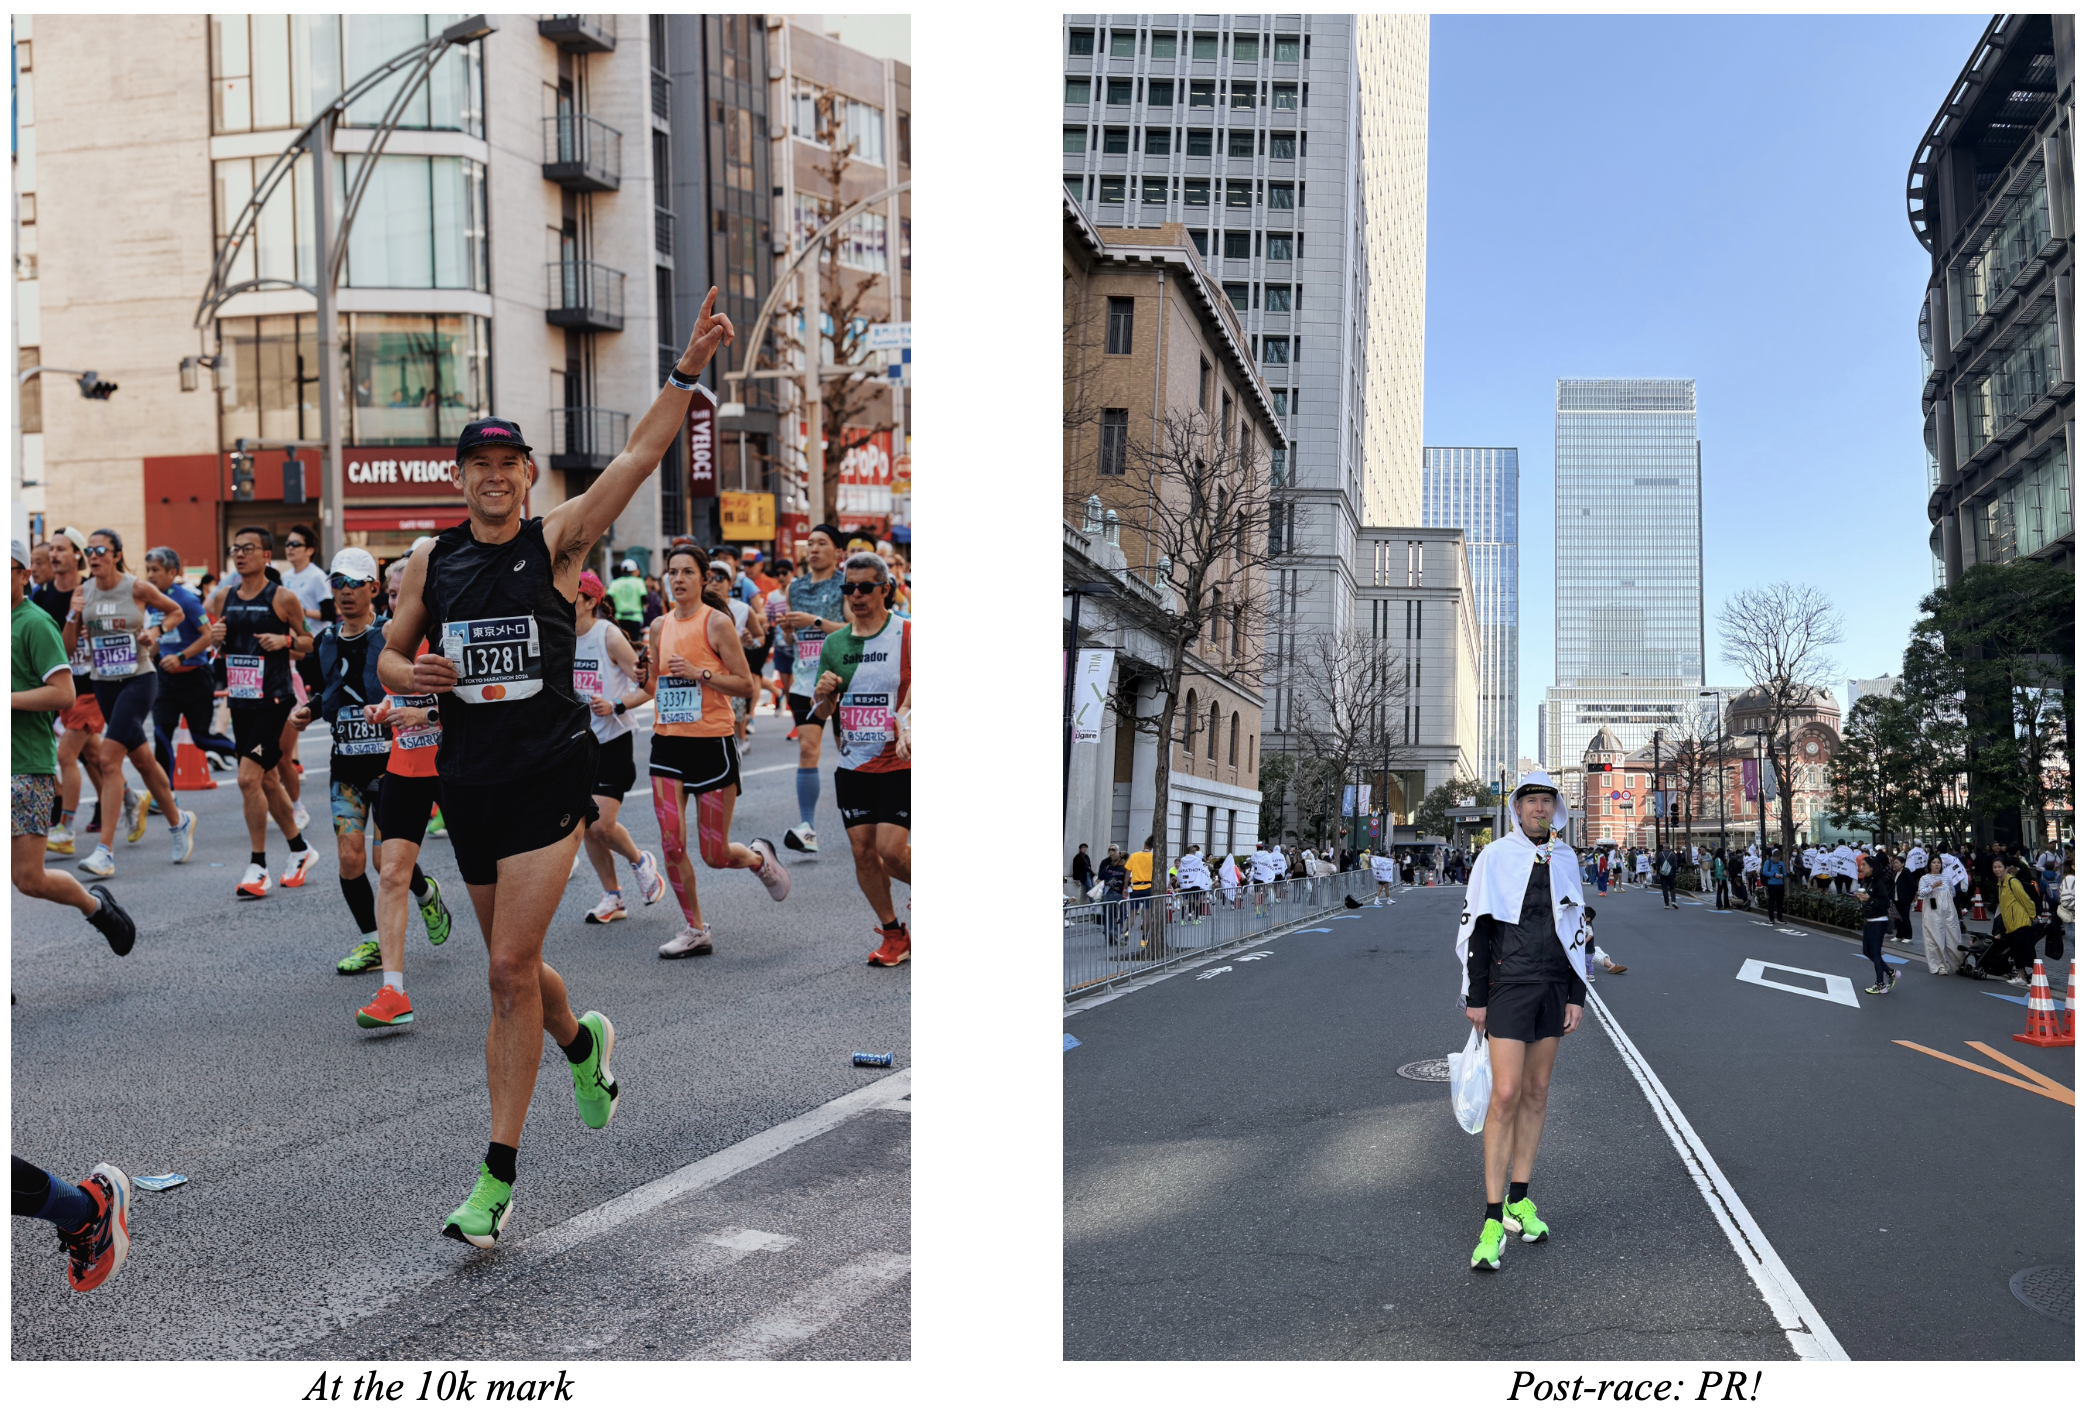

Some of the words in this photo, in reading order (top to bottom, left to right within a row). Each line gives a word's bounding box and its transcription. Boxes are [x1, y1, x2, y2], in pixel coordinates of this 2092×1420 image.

[691, 420, 712, 480] VELOCE
[472, 624, 526, 638] 東京メトロ
[102, 647, 130, 663] 31657
[467, 645, 524, 676] 13281
[842, 651, 888, 665] Salvador
[1088, 653, 1102, 674] WILL
[483, 675, 515, 683] MARATHON
[663, 691, 692, 707] 33371
[851, 709, 886, 726] 12665
[348, 721, 382, 739] 12891
